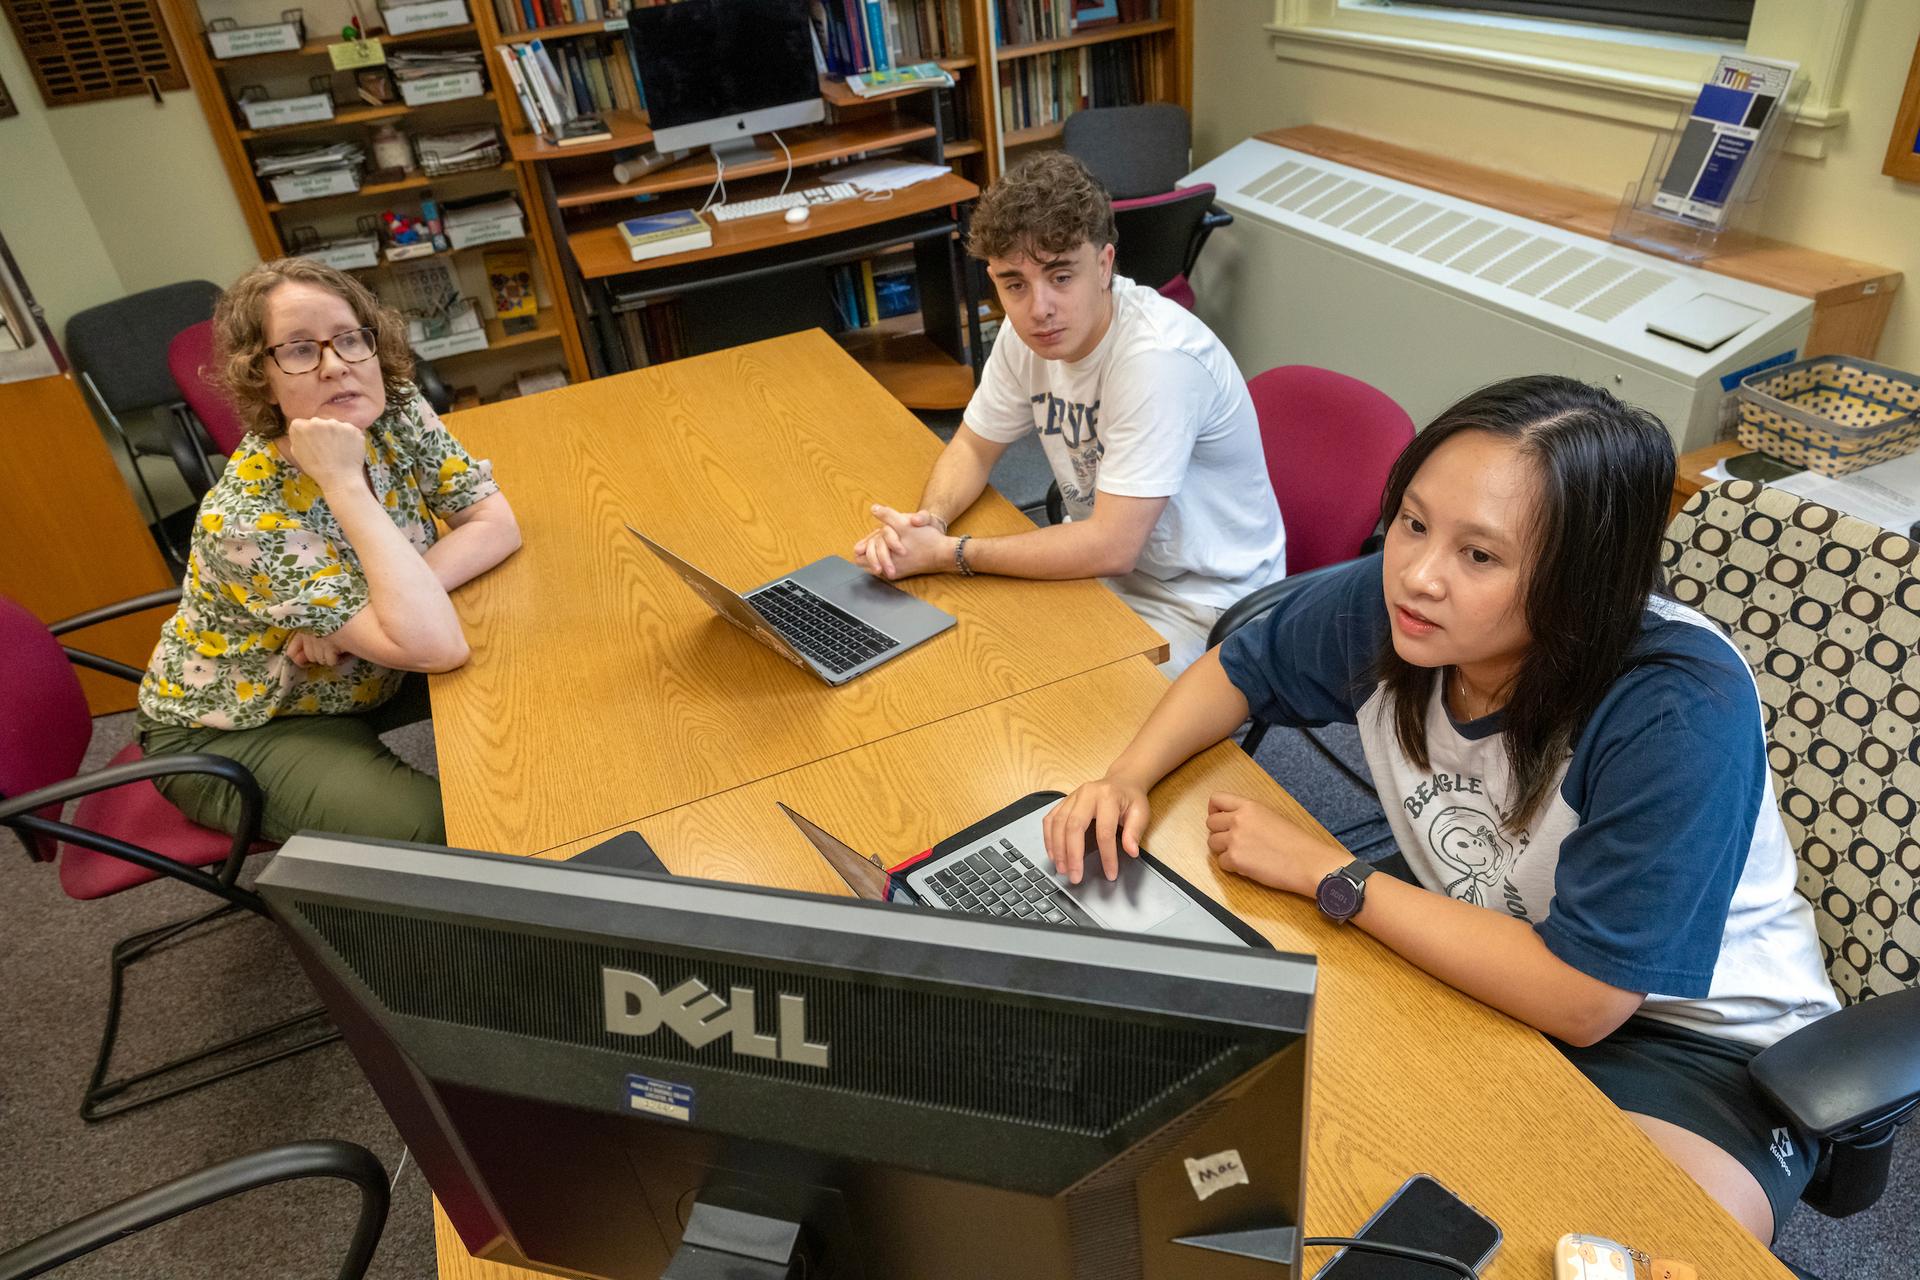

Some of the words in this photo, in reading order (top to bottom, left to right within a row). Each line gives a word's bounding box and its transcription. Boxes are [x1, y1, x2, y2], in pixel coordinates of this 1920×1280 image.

[1403, 773, 1483, 820] BEAGLE
[602, 967, 829, 1068] DELL
[1198, 1161, 1239, 1184] Mac
